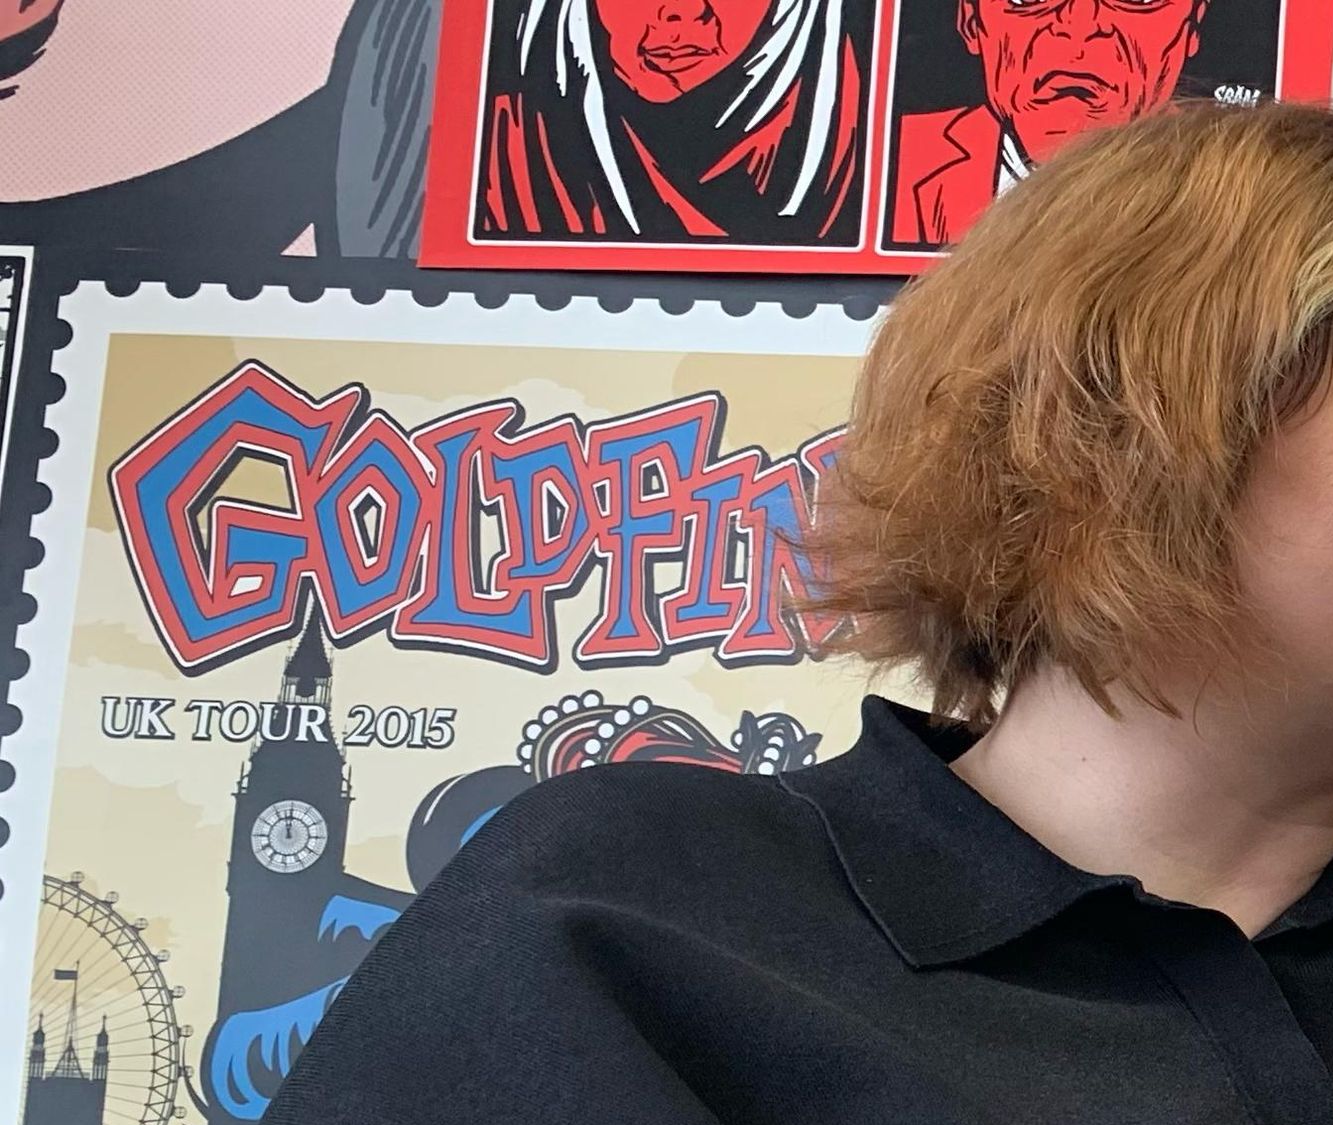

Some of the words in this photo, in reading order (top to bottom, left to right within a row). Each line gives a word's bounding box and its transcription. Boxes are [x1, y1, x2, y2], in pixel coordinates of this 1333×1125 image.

[101, 696, 176, 741] UK
[184, 700, 330, 744] TOUR
[343, 704, 458, 750] 2015
